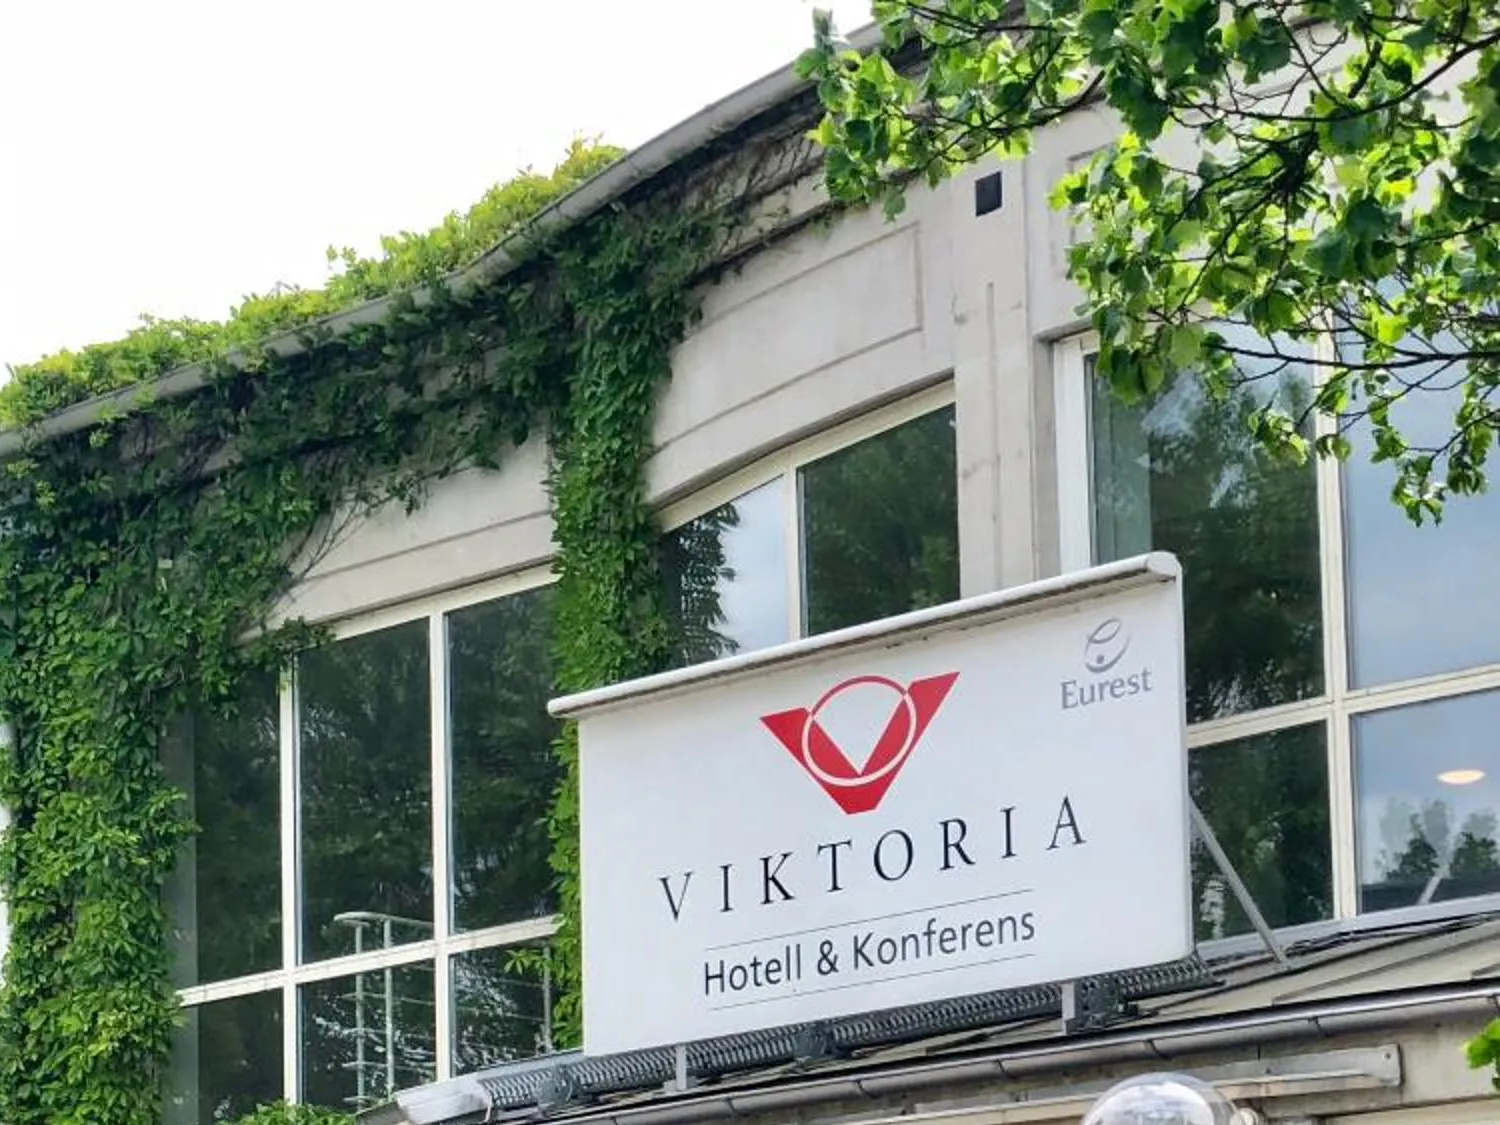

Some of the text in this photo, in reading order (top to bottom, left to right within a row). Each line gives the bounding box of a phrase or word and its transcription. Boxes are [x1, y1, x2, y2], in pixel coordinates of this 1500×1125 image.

[1061, 667, 1152, 709] Eurest
[660, 795, 1087, 922] VIKTORIA
[704, 909, 1036, 996] Hotell & Konferens
